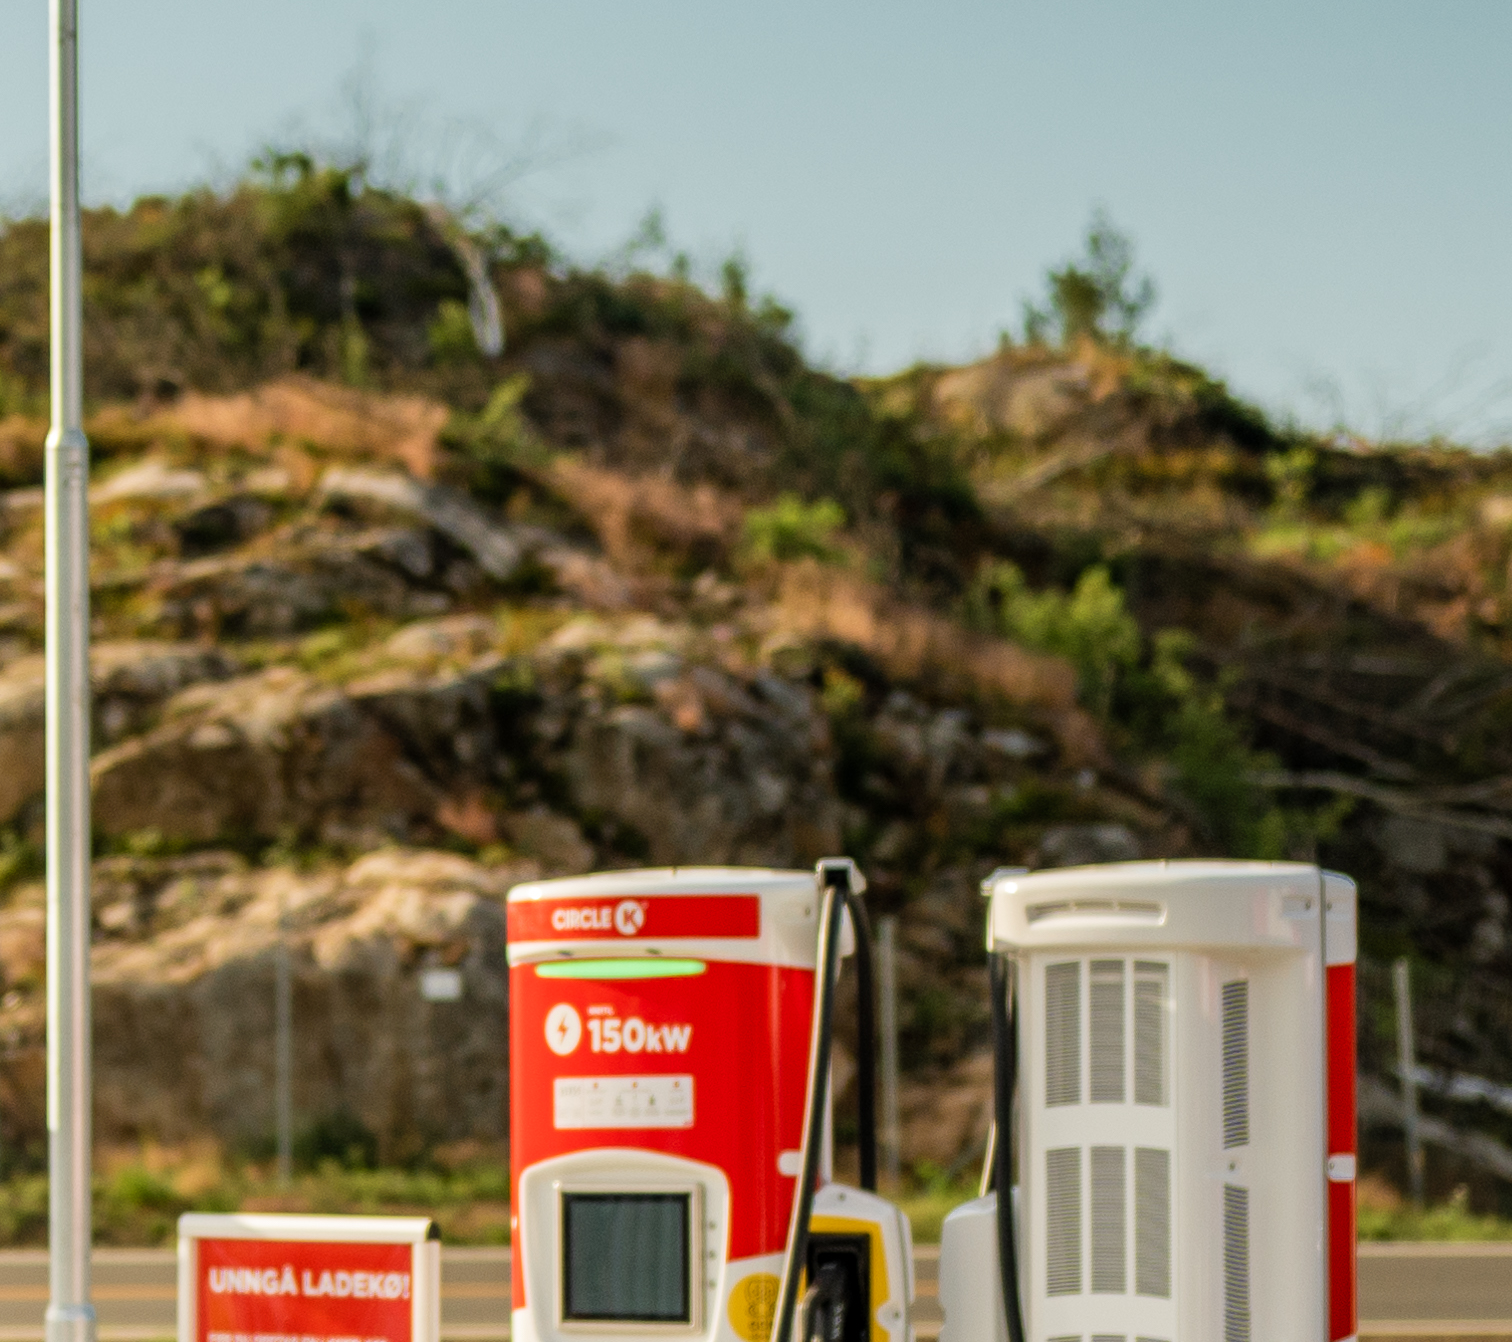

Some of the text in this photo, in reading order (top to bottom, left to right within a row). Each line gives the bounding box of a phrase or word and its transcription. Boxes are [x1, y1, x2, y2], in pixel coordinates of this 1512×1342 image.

[551, 907, 612, 931] CIRCLE
[587, 1018, 692, 1054] 150kW
[208, 1263, 411, 1300] UNNGÅ LADEKØ!
